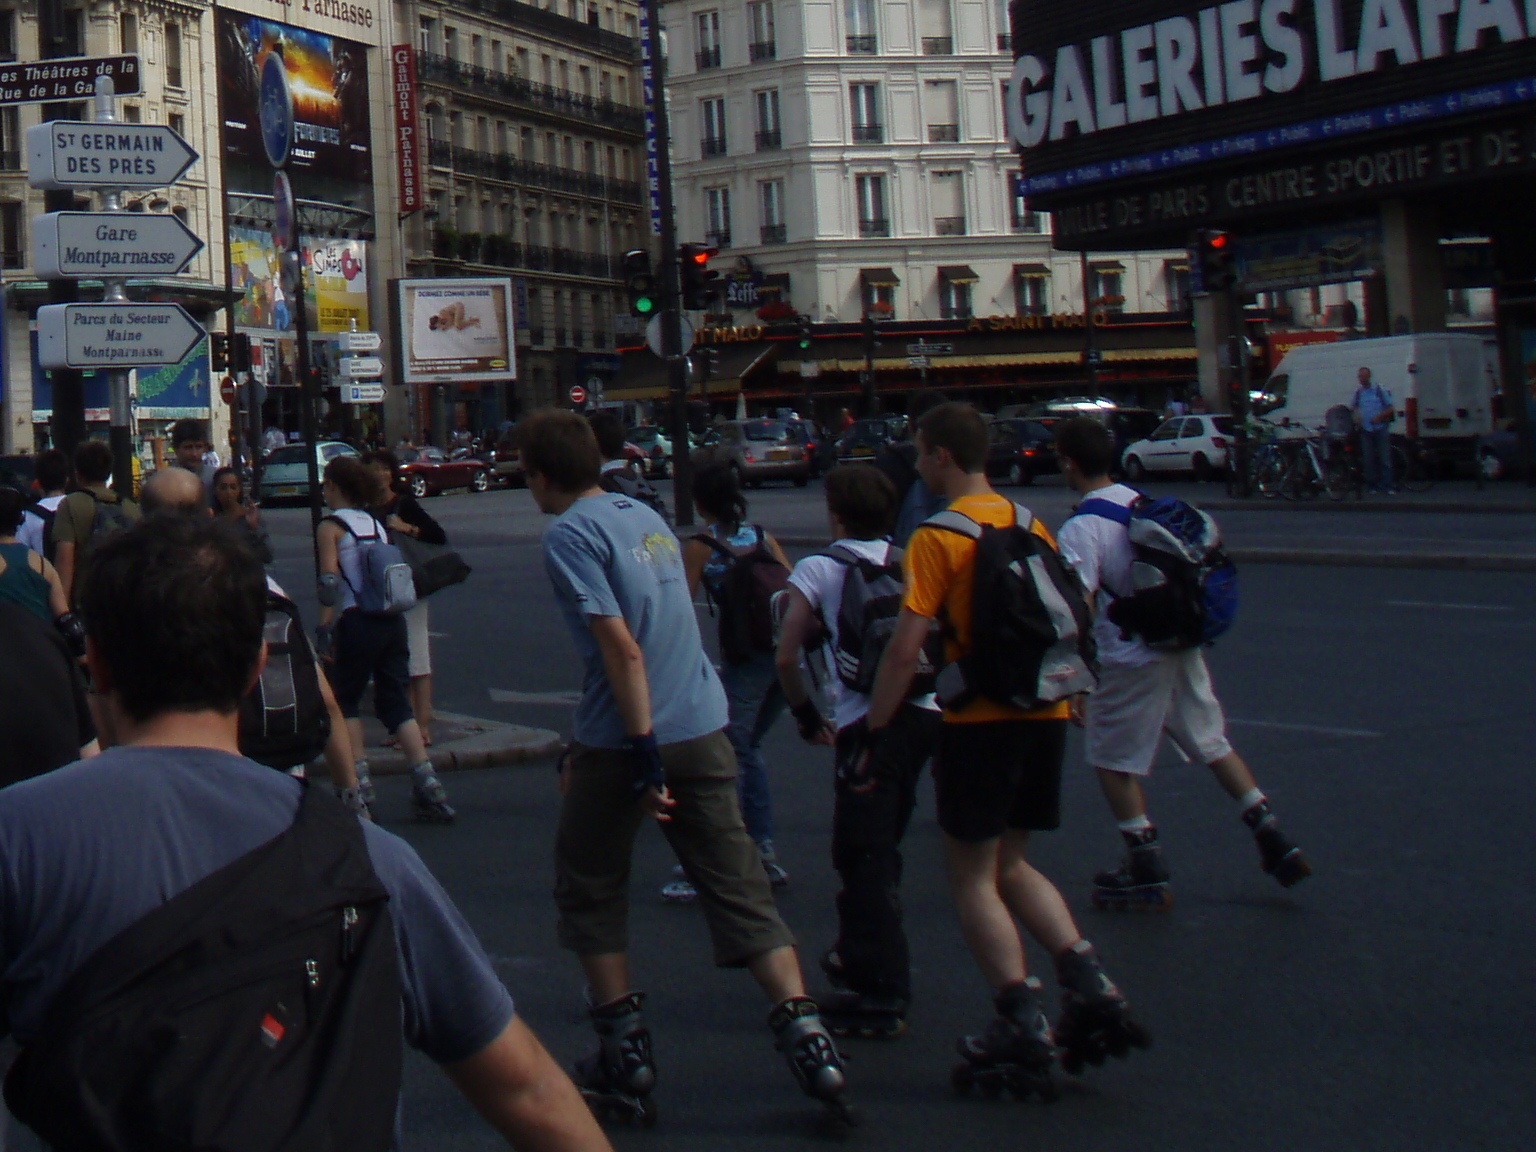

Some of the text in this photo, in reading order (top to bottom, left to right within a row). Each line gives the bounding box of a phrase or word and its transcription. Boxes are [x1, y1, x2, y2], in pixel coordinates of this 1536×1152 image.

[25, 65, 89, 81] Théâtres
[96, 61, 113, 76] de
[120, 60, 135, 74] la
[29, 84, 47, 98] de
[54, 82, 68, 96] la
[394, 50, 414, 206] Gaumont Parnasse
[81, 133, 163, 152] GERMAIN
[67, 156, 101, 174] DES
[1114, 194, 1144, 226] DE
[1148, 183, 1210, 219] PARIS
[1225, 164, 1318, 209] CENTRE
[1325, 144, 1433, 194] SPORTIF
[1439, 137, 1473, 175] ET
[1482, 129, 1521, 168] DE
[96, 224, 138, 242] Gare
[64, 246, 176, 268] Montparnasse
[73, 312, 171, 325] Parcs du Secteur
[105, 329, 142, 341] Maine
